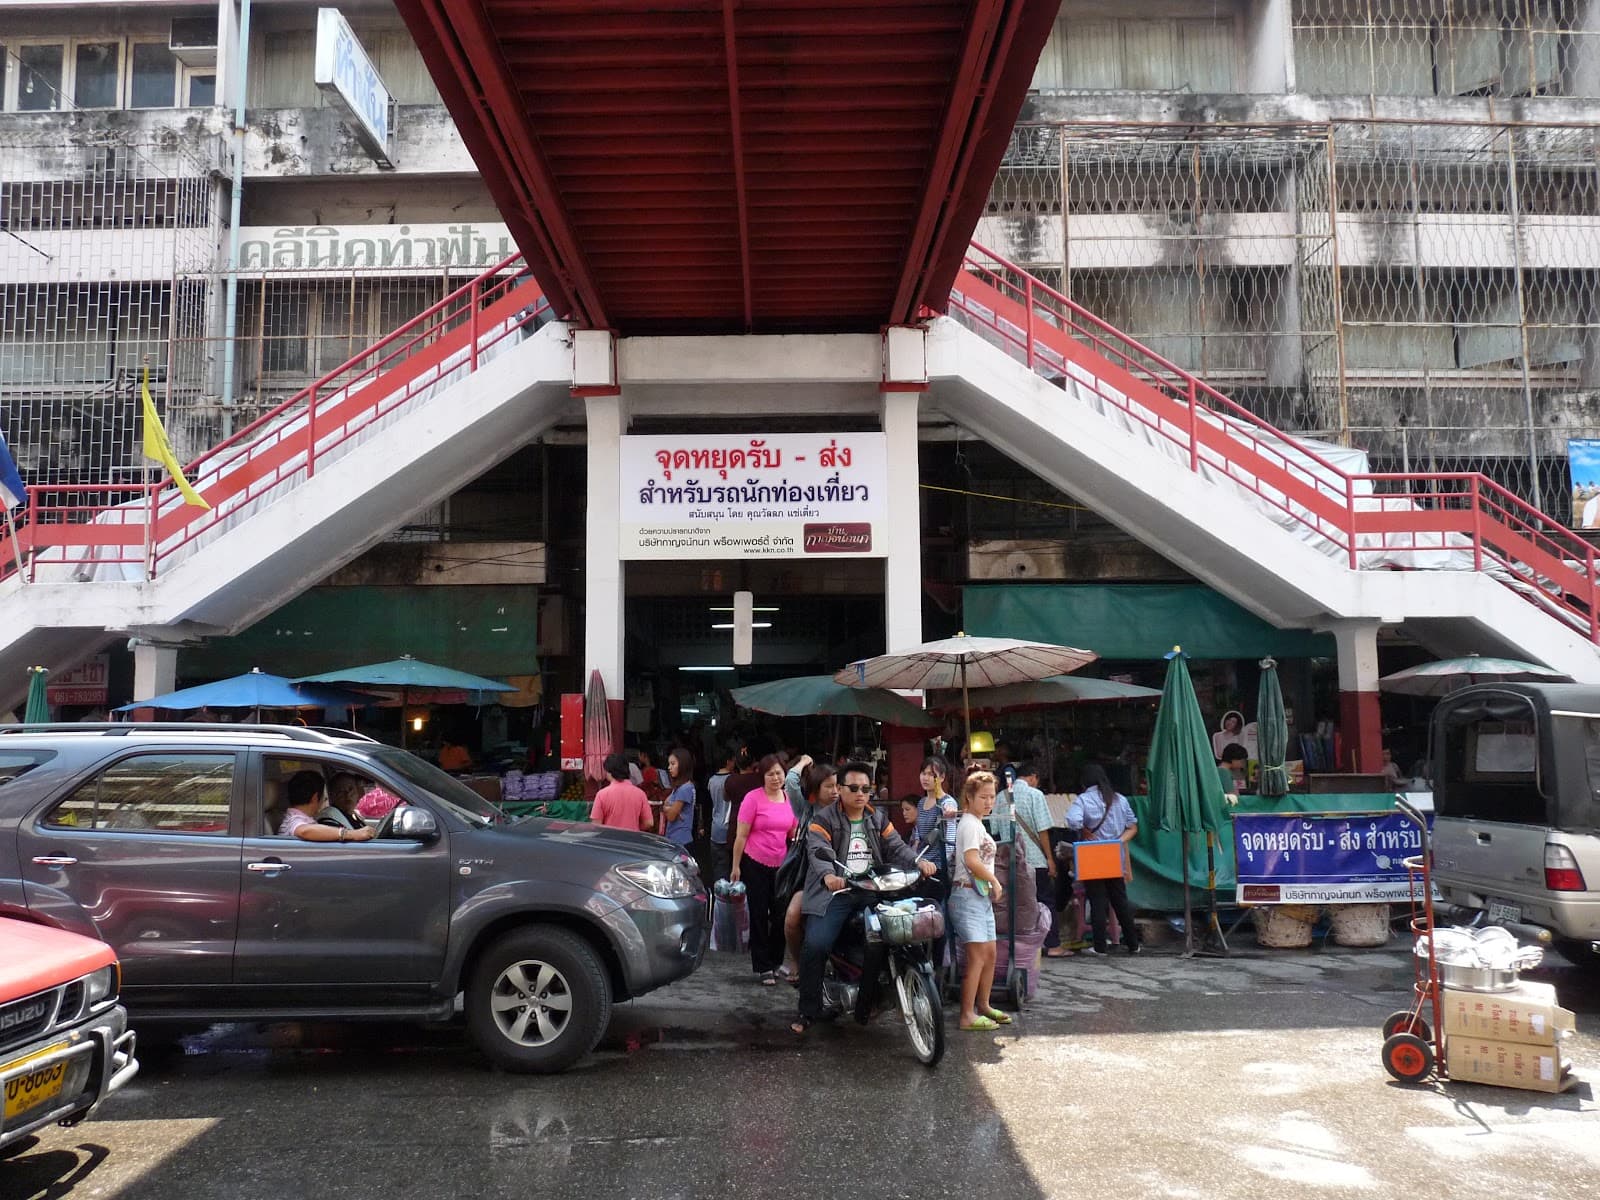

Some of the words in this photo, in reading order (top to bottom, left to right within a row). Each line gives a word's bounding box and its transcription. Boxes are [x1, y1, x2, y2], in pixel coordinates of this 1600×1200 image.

[655, 440, 782, 480] จุดหยุดรับ
[819, 439, 851, 468] ส่ง
[638, 471, 869, 505] สำหรับรถนักท่องเที่ยว
[728, 508, 743, 518] โดย
[1241, 822, 1324, 862] จุดหยุดรับ
[1340, 823, 1361, 850] ส่ง
[1366, 820, 1422, 850] สำหรับ
[1, 1002, 45, 1029] ISUZU
